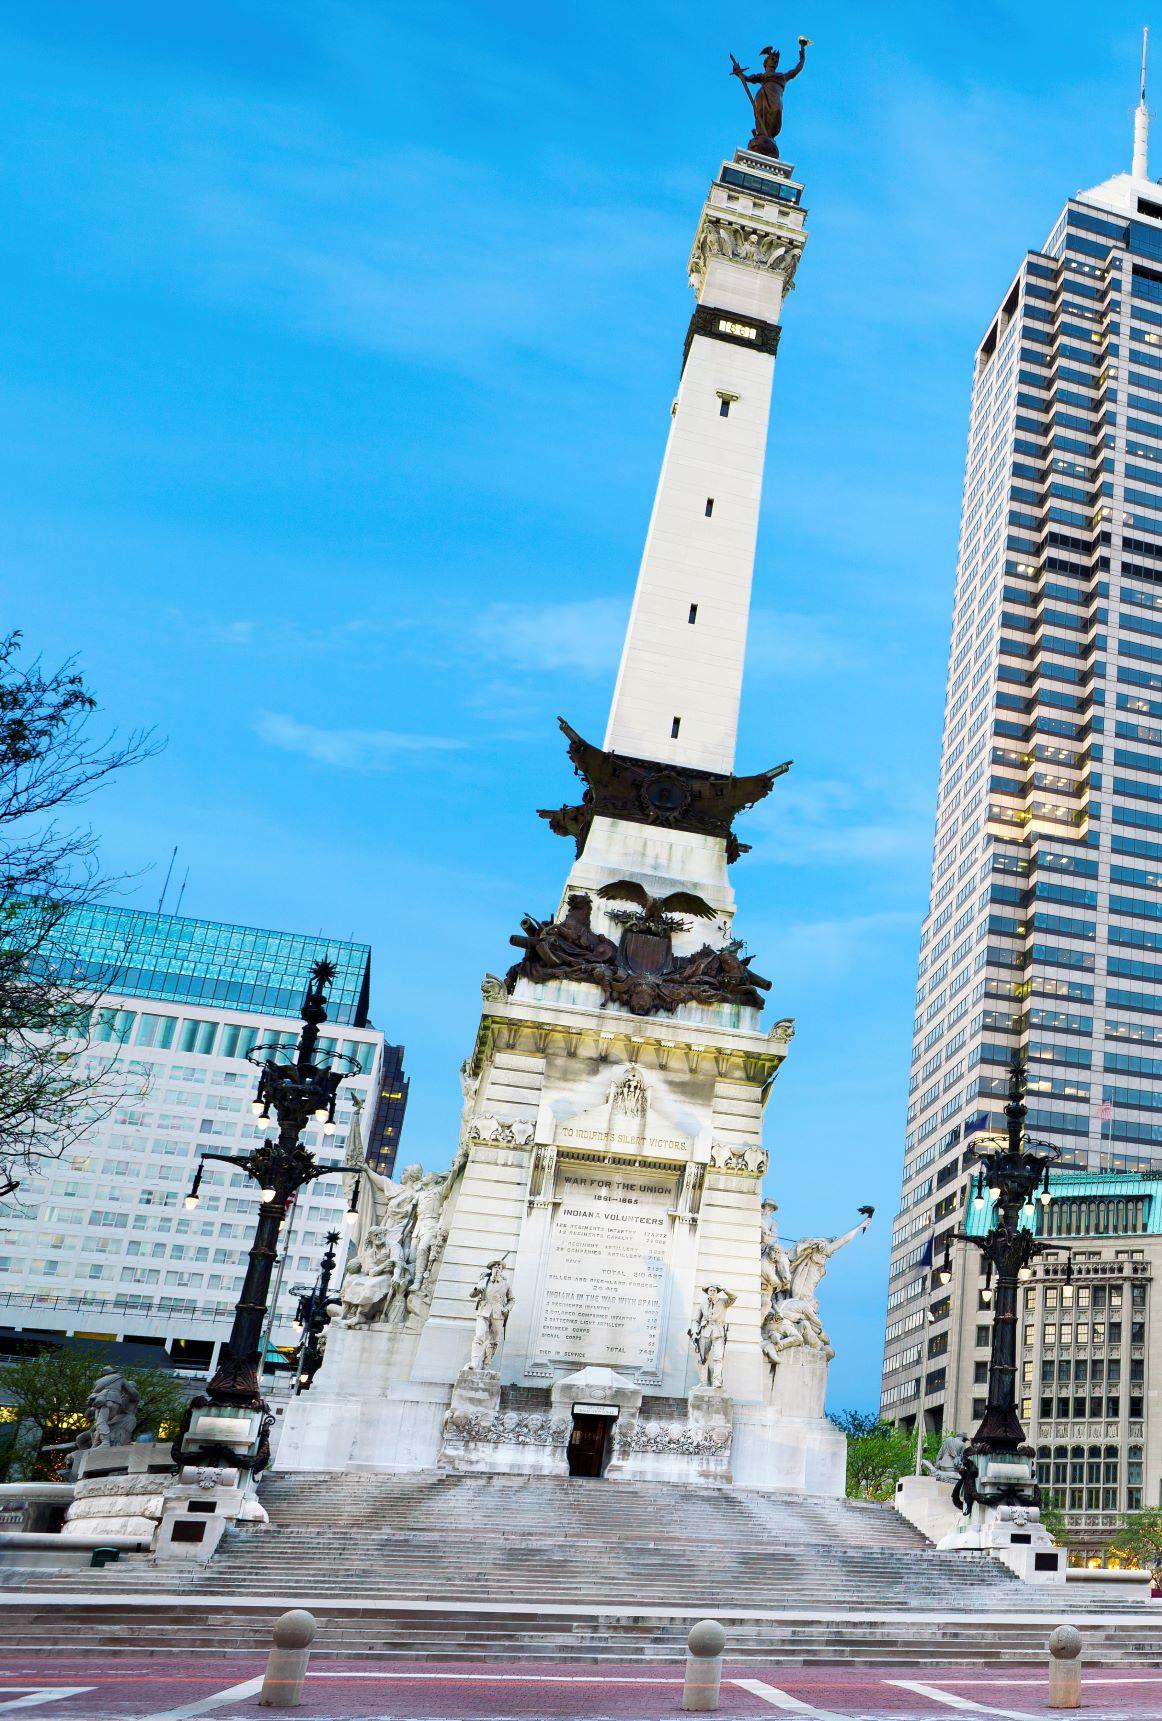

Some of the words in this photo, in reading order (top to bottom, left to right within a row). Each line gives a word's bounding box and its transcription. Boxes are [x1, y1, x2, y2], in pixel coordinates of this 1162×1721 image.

[562, 1127, 574, 1137] TO
[575, 1129, 615, 1142] INDIANA'S
[617, 1134, 647, 1145] SILENT
[649, 1138, 687, 1151] VICTORS.
[564, 1176, 587, 1186] WAR
[590, 1179, 612, 1189] FOR
[615, 1182, 636, 1191] THE
[639, 1185, 672, 1195] UNION
[563, 1209, 600, 1219] INDIANA
[604, 1213, 664, 1226] VOLUNTEERS
[602, 1269, 626, 1277] TOTAL
[546, 1290, 575, 1300] INDIANA
[586, 1294, 600, 1302] THE
[606, 1346, 626, 1354] TOTAL
